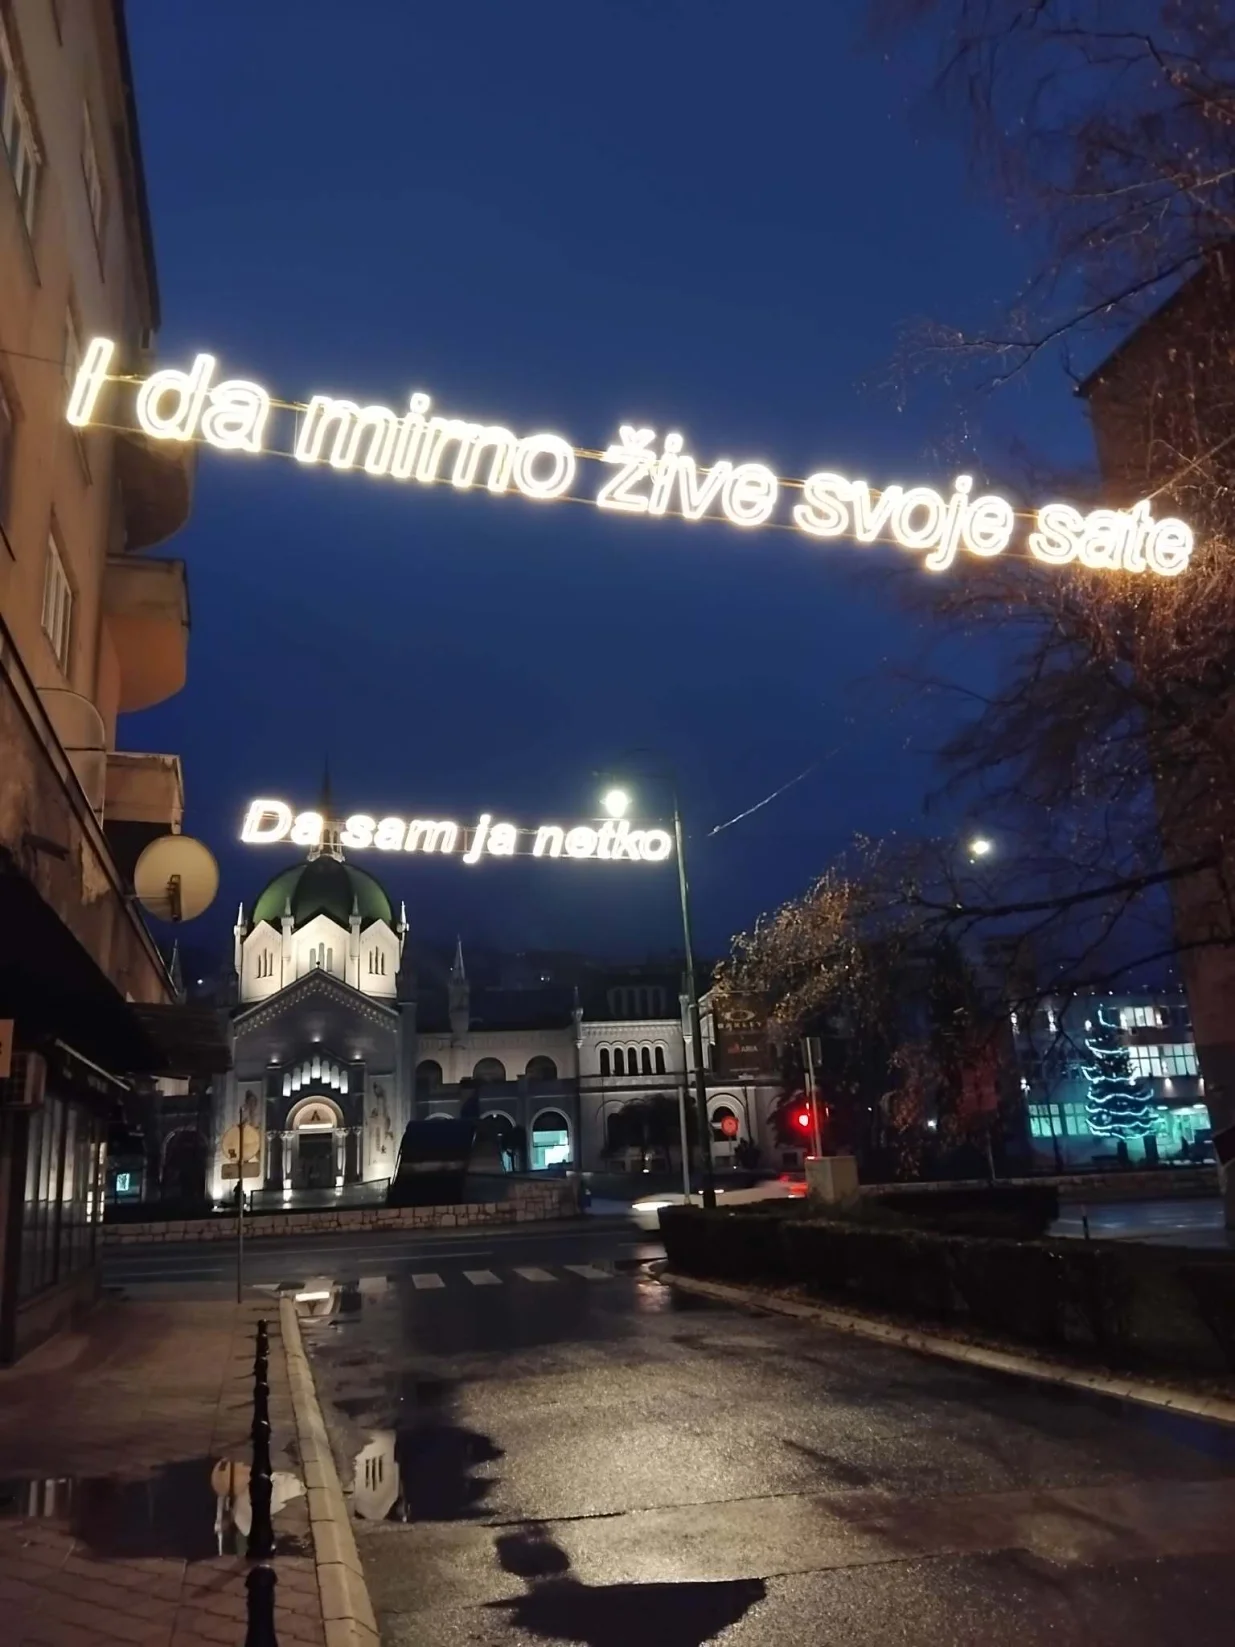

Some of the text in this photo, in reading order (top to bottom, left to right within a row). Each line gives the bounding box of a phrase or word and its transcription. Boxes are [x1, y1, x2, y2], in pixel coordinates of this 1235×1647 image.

[66, 337, 1195, 577] I da mimo žive svoje sate
[241, 799, 673, 865] Da sam ja netko
